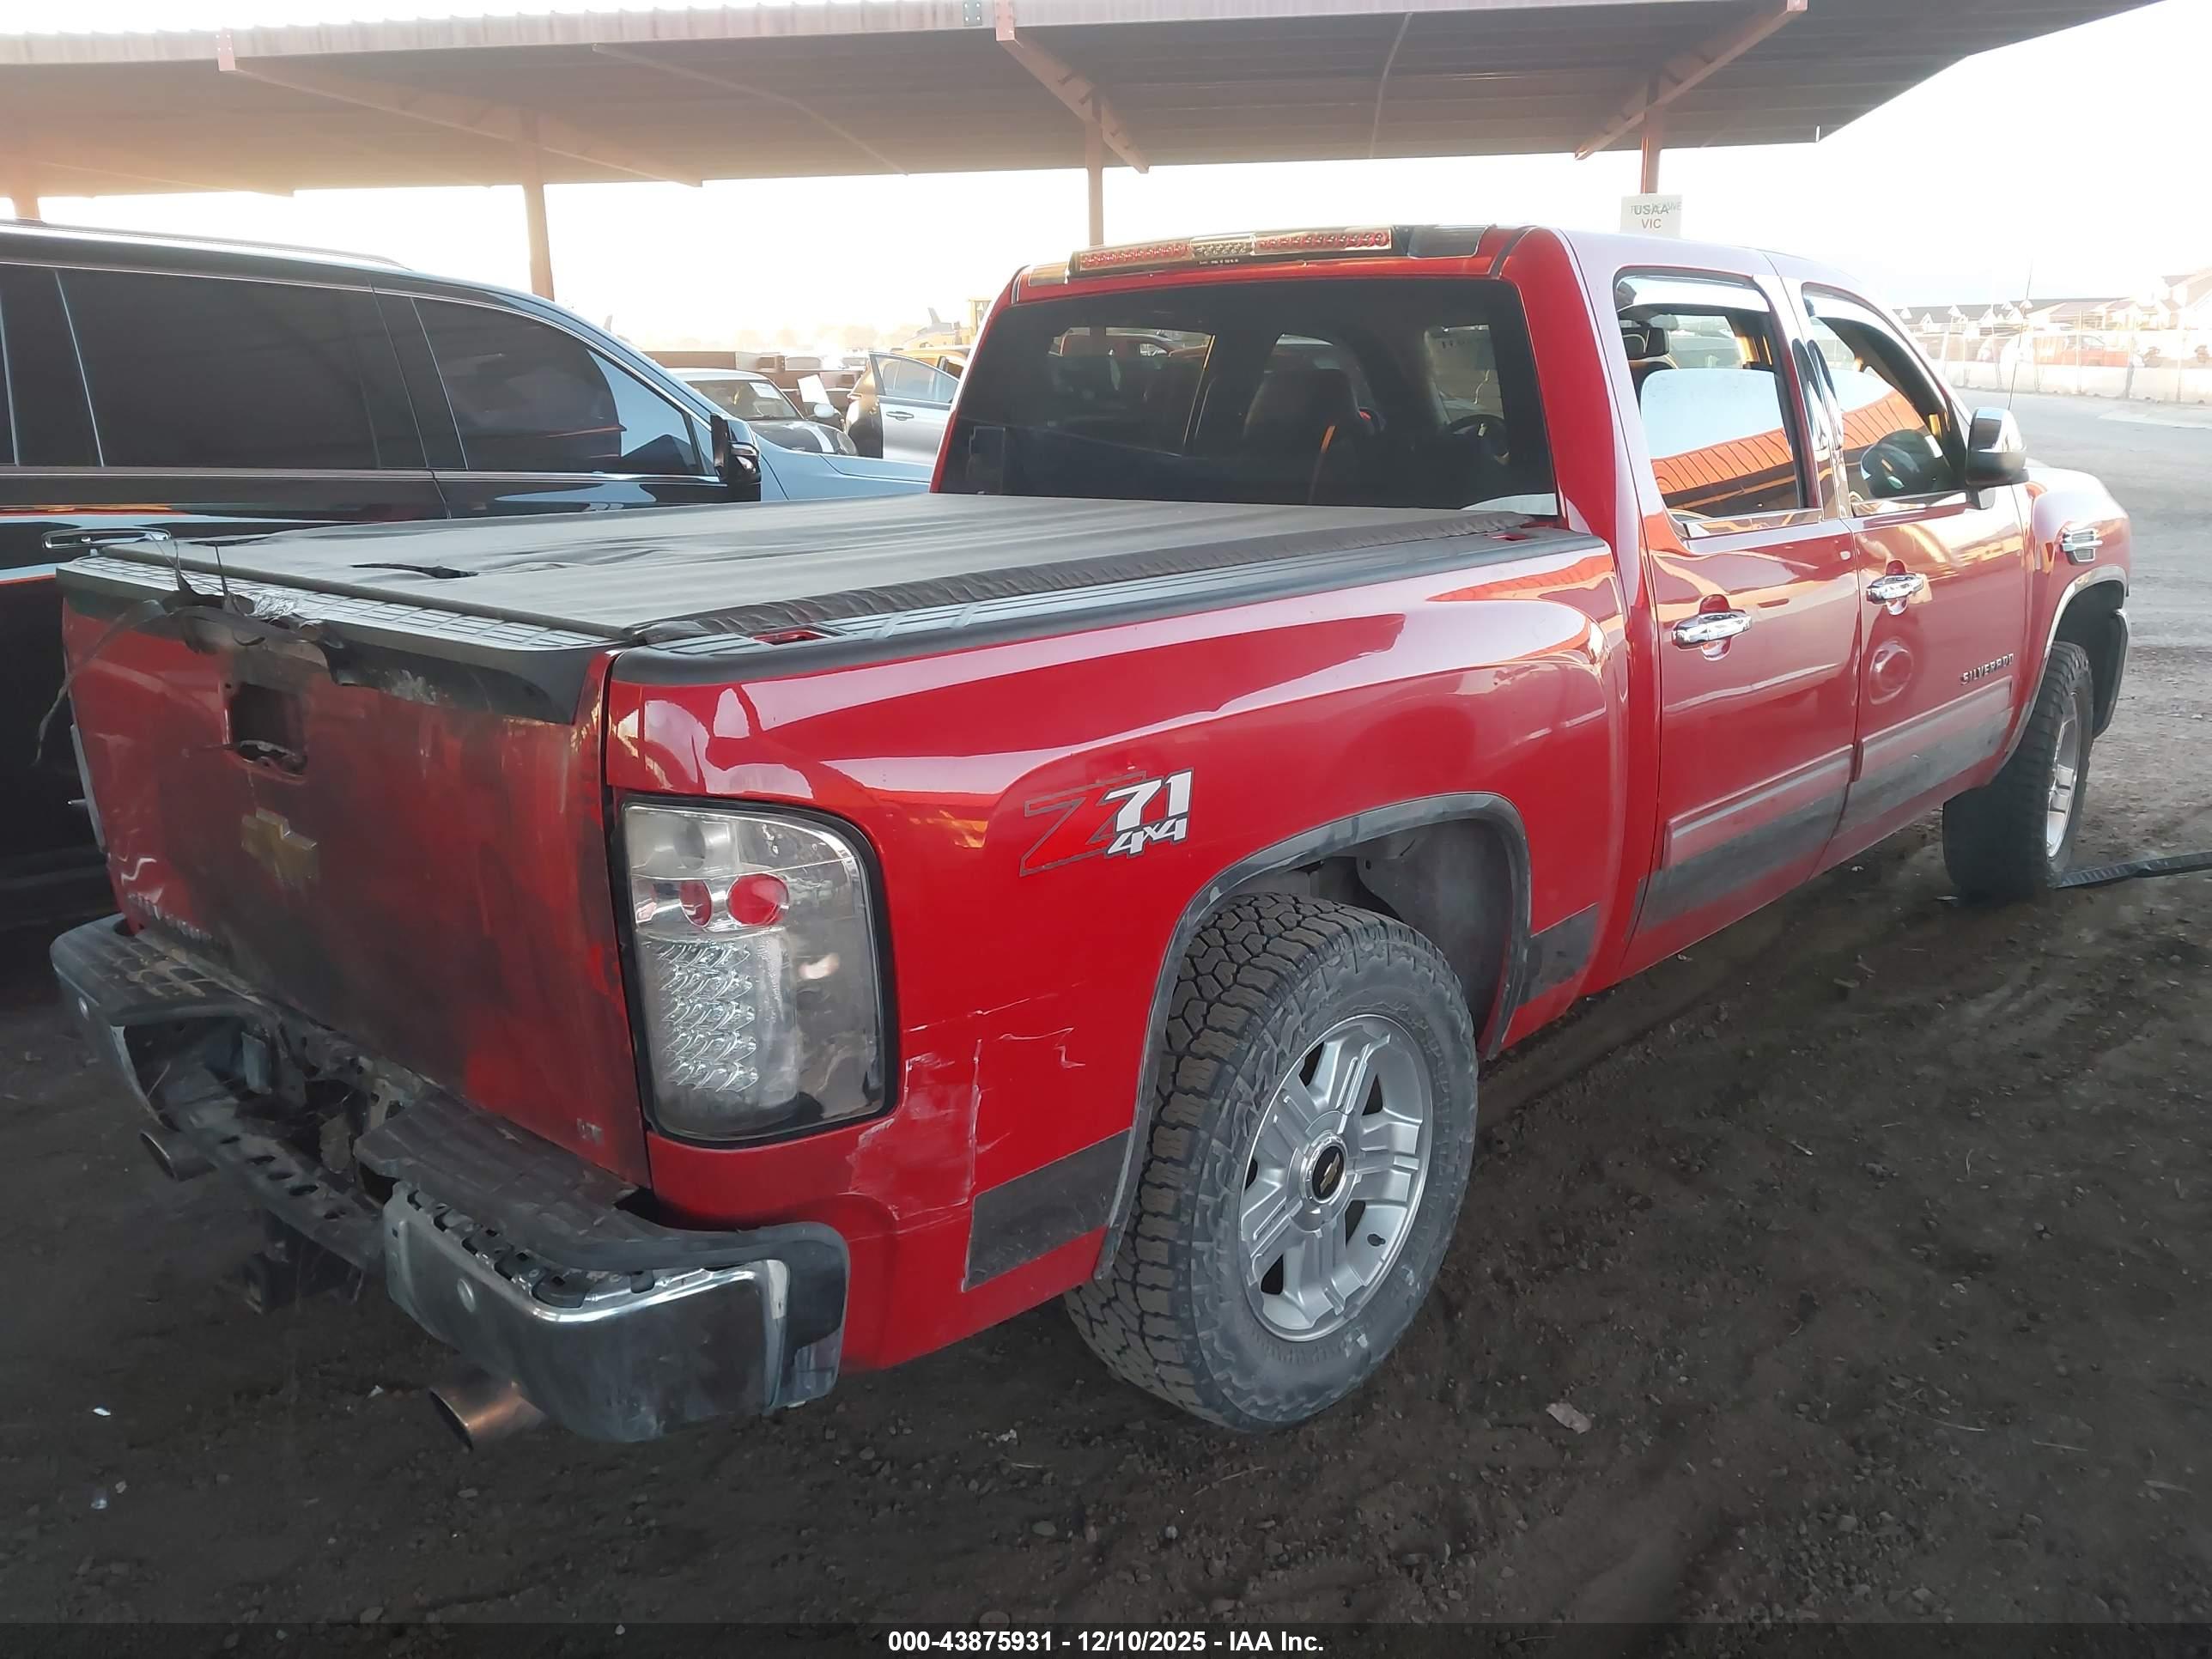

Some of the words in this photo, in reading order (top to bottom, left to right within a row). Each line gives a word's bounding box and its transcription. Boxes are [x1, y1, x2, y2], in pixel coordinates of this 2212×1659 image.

[1633, 204, 1669, 215] USAA
[1641, 218, 1662, 229] VIC
[1960, 653, 2014, 685] SILVERADO
